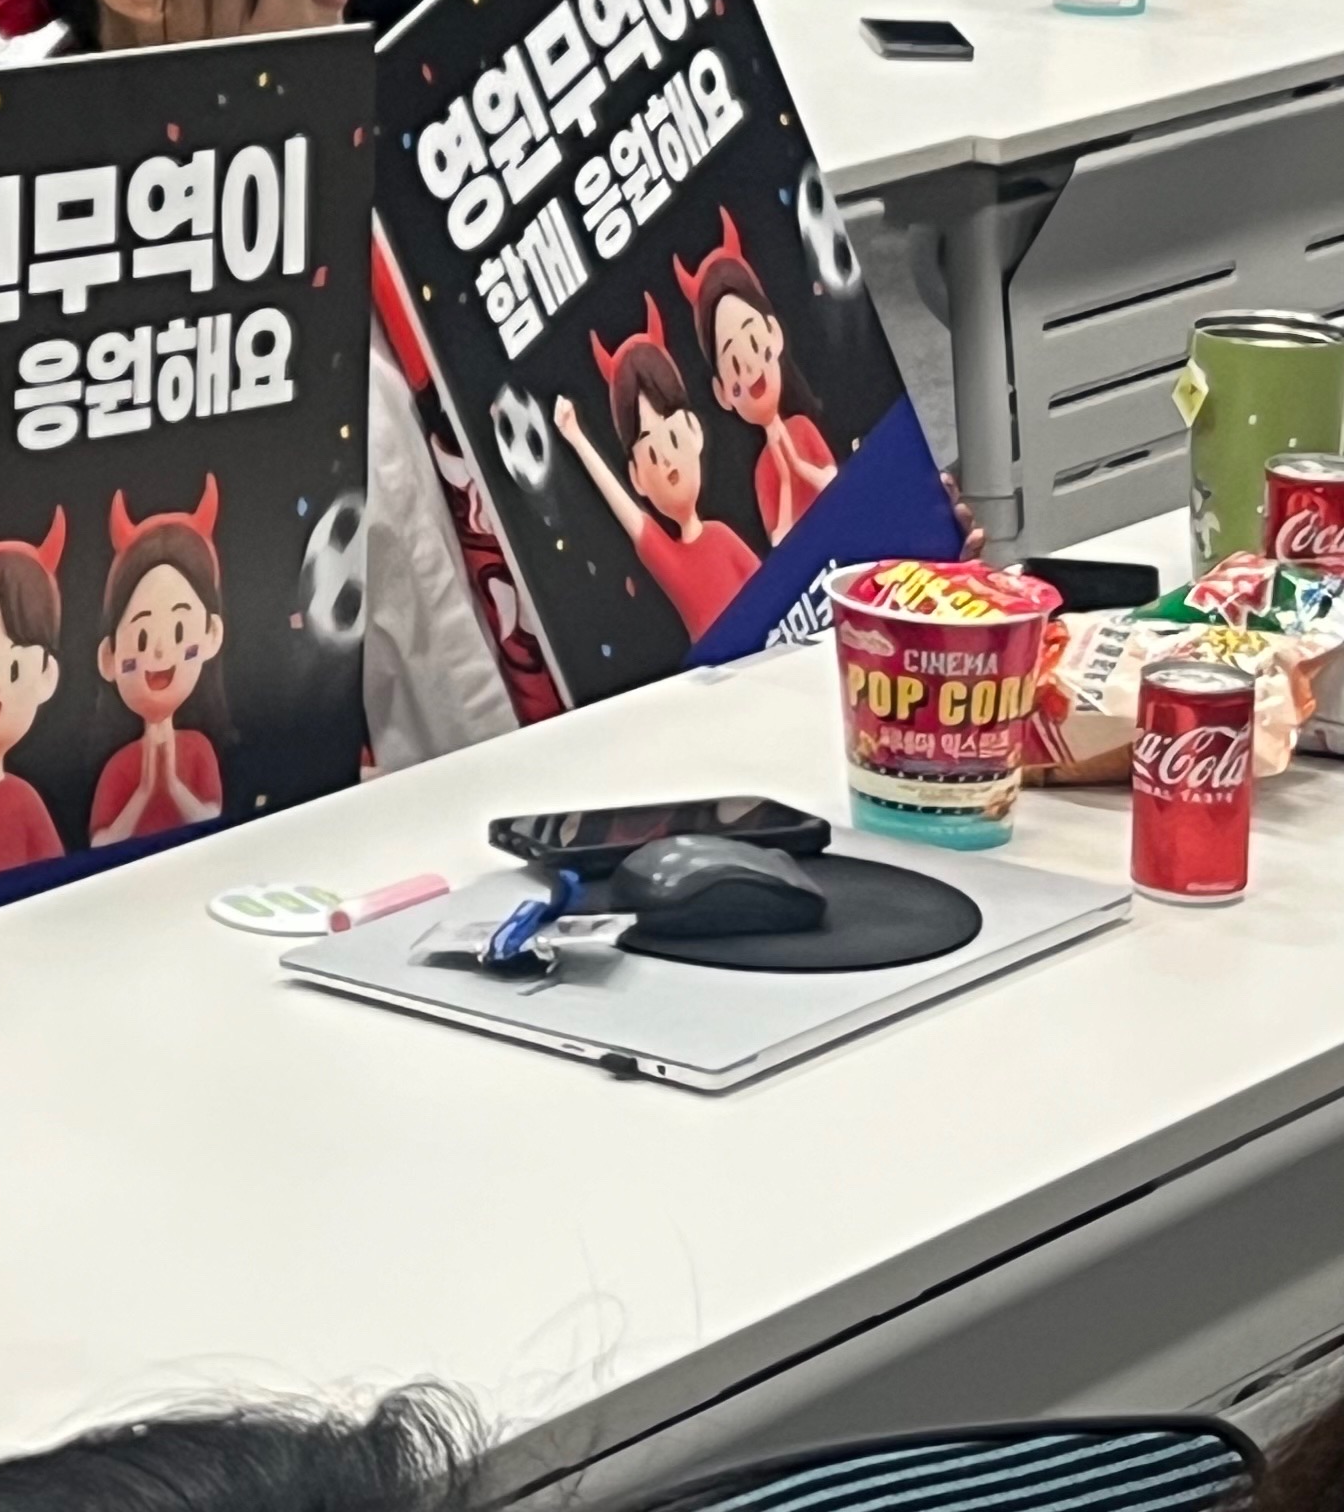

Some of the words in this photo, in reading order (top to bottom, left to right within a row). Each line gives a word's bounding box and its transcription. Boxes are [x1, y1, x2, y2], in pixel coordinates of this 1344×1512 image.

[474, 198, 591, 361] 함께
[572, 47, 745, 261] 응원해요
[13, 306, 295, 453] 응원해요
[847, 662, 925, 722] POP
[903, 648, 999, 676] CINEMA
